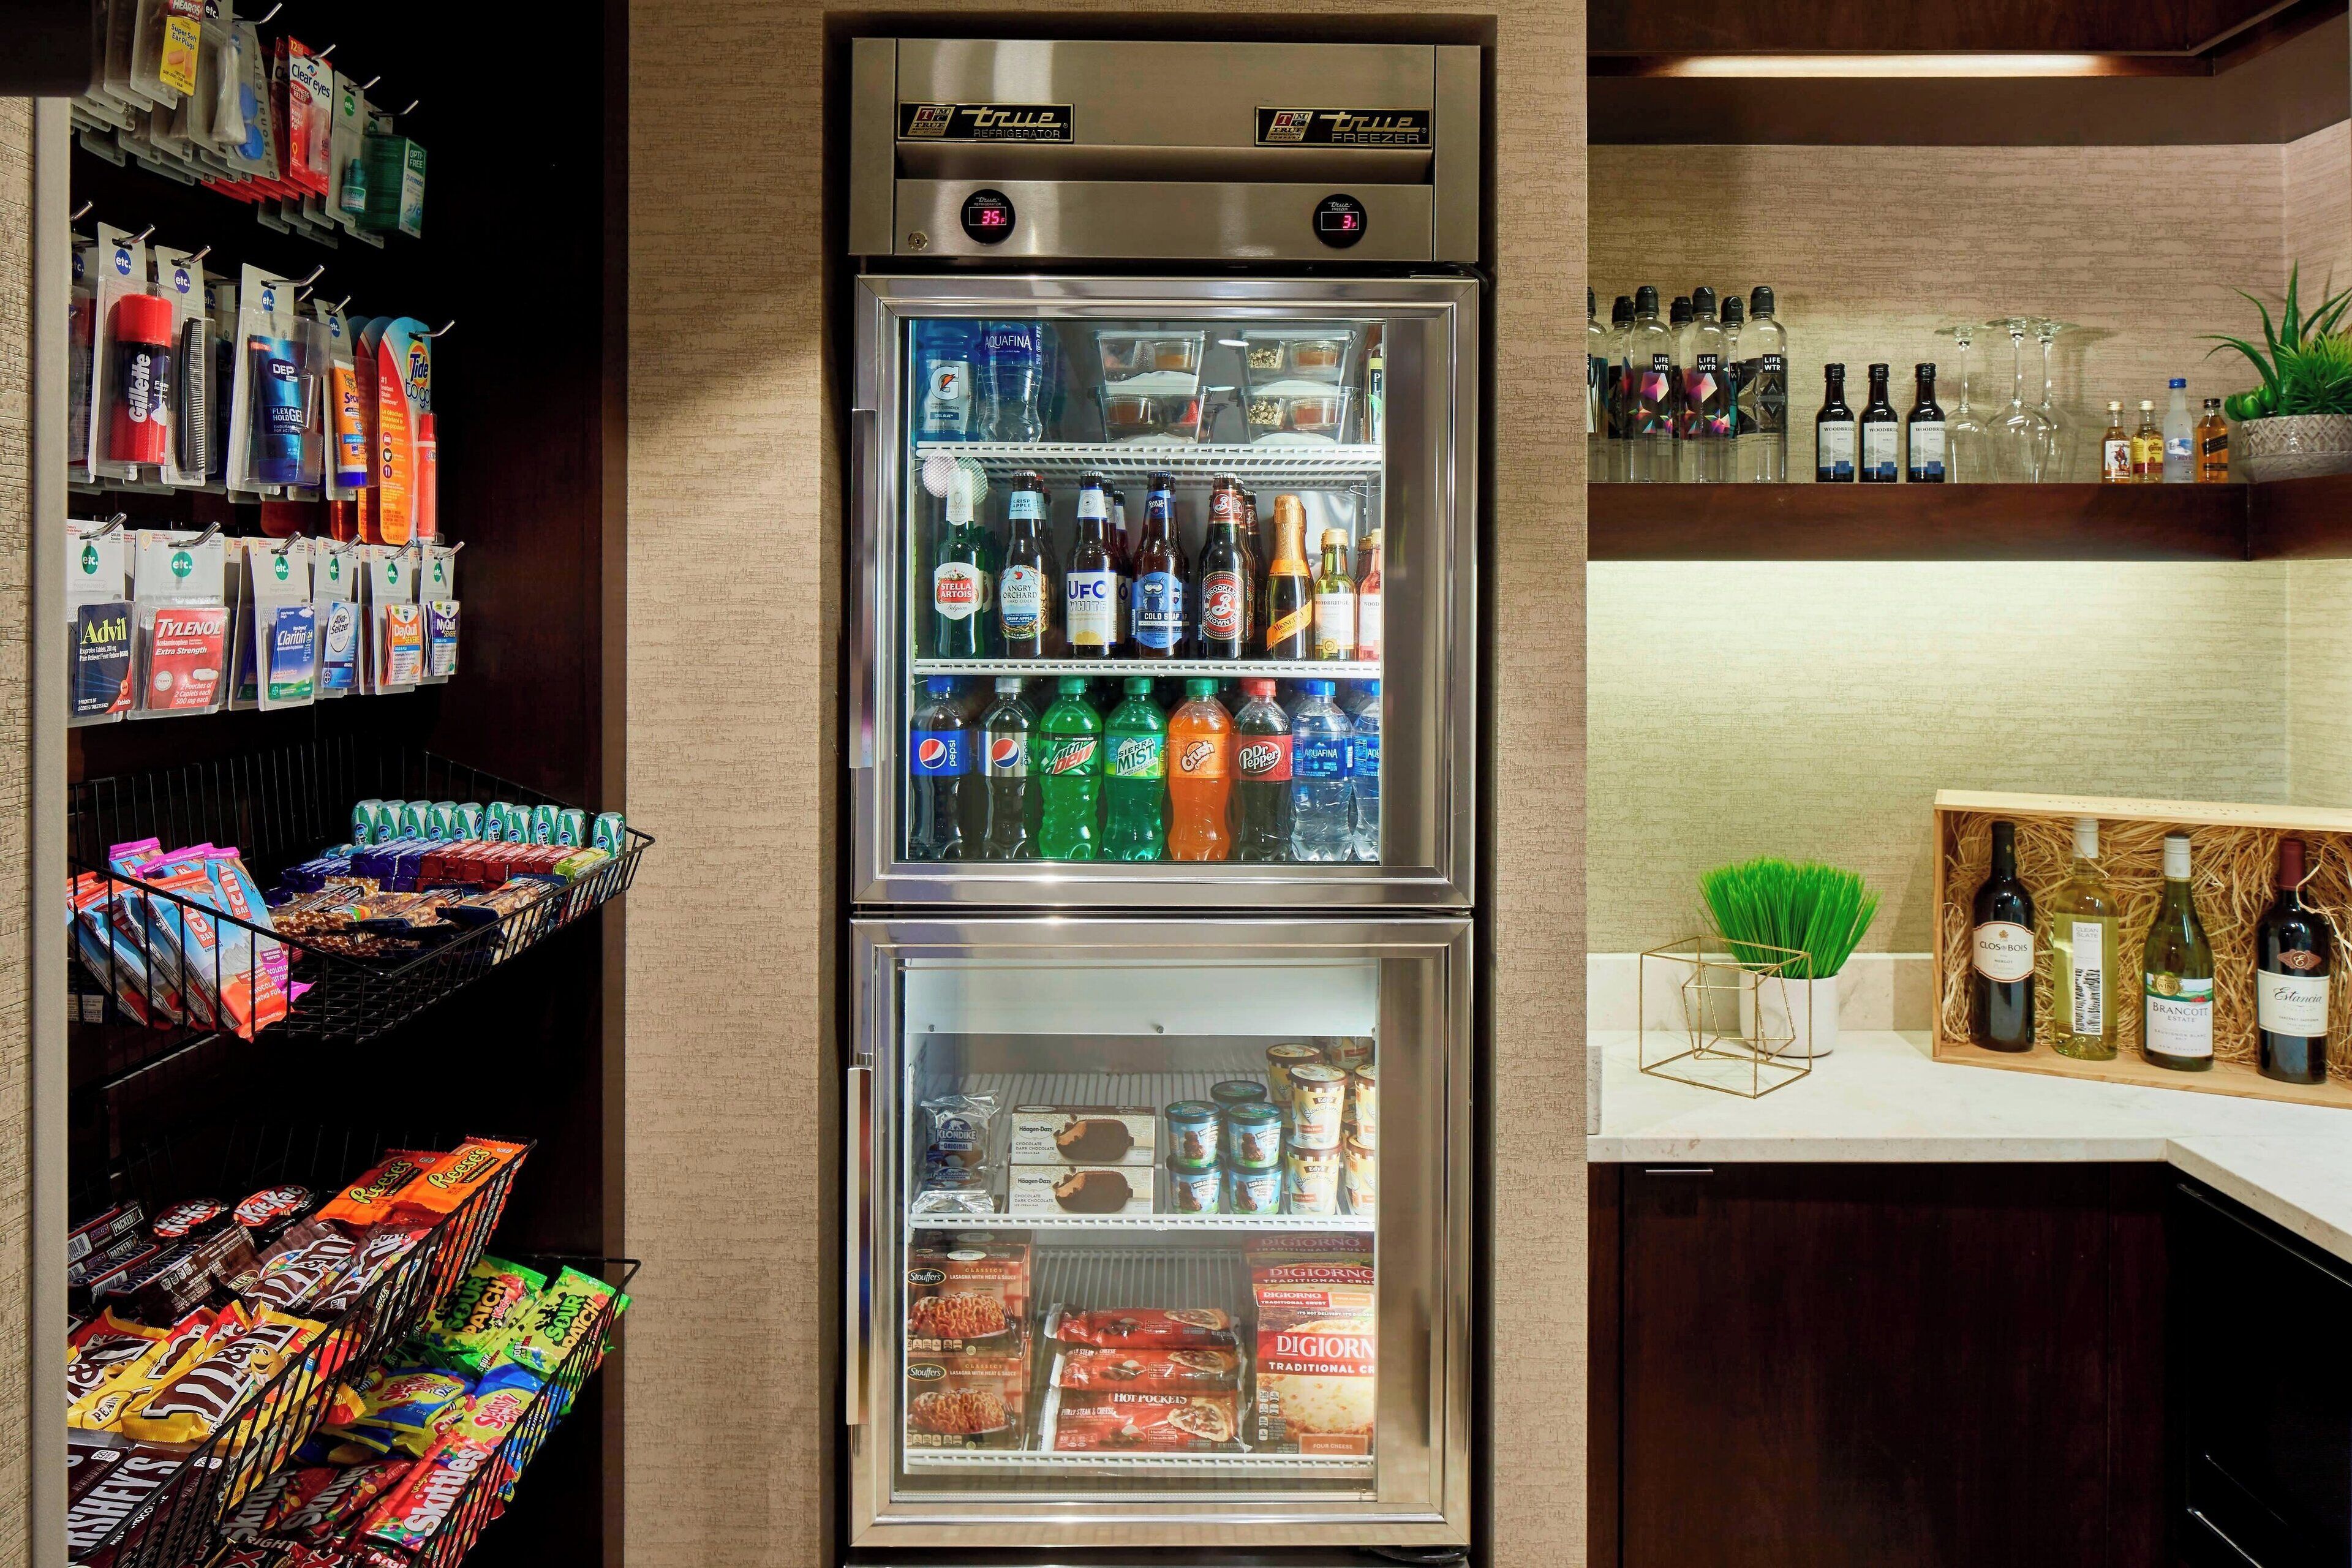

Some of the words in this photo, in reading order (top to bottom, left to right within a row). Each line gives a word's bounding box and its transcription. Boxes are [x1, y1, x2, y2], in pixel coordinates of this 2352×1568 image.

[206, 6, 219, 19] etc.
[171, 24, 187, 36] Super
[187, 32, 197, 42] Soft
[172, 32, 181, 41] Ear
[182, 38, 194, 50] Plugs
[292, 64, 312, 85] Clear
[313, 79, 330, 97] eyes
[345, 101, 355, 113] etc.
[962, 107, 1062, 128] true
[1319, 112, 1420, 132] true
[974, 129, 1060, 138] REFRIGERATOR
[1332, 134, 1419, 143] FREEZER
[409, 159, 423, 168] FREE
[116, 257, 131, 270] etc.
[175, 276, 190, 287] etc.
[263, 296, 274, 306] etc.
[984, 335, 1033, 350] AQUAFINA
[273, 364, 295, 375] DEP
[410, 353, 429, 382] Tide
[128, 353, 151, 423] Gillette
[405, 379, 418, 399] to
[420, 387, 429, 409] go
[83, 556, 98, 566] etc.
[173, 560, 192, 569] etc.
[276, 564, 288, 573] etc.
[1068, 579, 1109, 600] UFO
[1068, 600, 1108, 611] WHITE
[334, 616, 347, 625] Alka-
[1206, 611, 1229, 625] BROWN
[80, 617, 127, 644] Advil
[157, 619, 223, 638] TYLENOL
[331, 623, 349, 635] Seltzer
[394, 624, 417, 639] DayQuil
[437, 619, 455, 633] NyQuil
[278, 630, 306, 646] Claritin
[177, 646, 207, 655] Strength
[948, 739, 957, 767] pepsi
[1118, 739, 1153, 758] SIERRA
[1253, 745, 1268, 758] Dr
[1304, 748, 1338, 758] AQUAFINA
[1117, 744, 1155, 774] MIST
[1182, 741, 1215, 772] Crush
[1240, 748, 1278, 769] Pepper
[235, 906, 249, 915] BAR
[1980, 941, 2001, 950] CLOS
[2273, 987, 2323, 1003] Estancia
[2153, 1001, 2208, 1016] BRANCOTT
[937, 1129, 977, 1141] KLONDIKE
[428, 1148, 491, 1188] Reese's
[350, 1160, 414, 1204] Reese's
[113, 1215, 134, 1233] PACKED
[1261, 1238, 1360, 1247] DIGIORNO
[910, 1272, 941, 1282] Stouffer's
[545, 1294, 586, 1342] SOUR
[910, 1367, 941, 1378] Stouffer's
[1268, 1362, 1355, 1374] TRADITIONAL
[1114, 1393, 1137, 1403] HOT
[1139, 1395, 1188, 1404] POCKETS
[403, 1447, 489, 1537] Skittles
[247, 1536, 297, 1551] RIGHT
